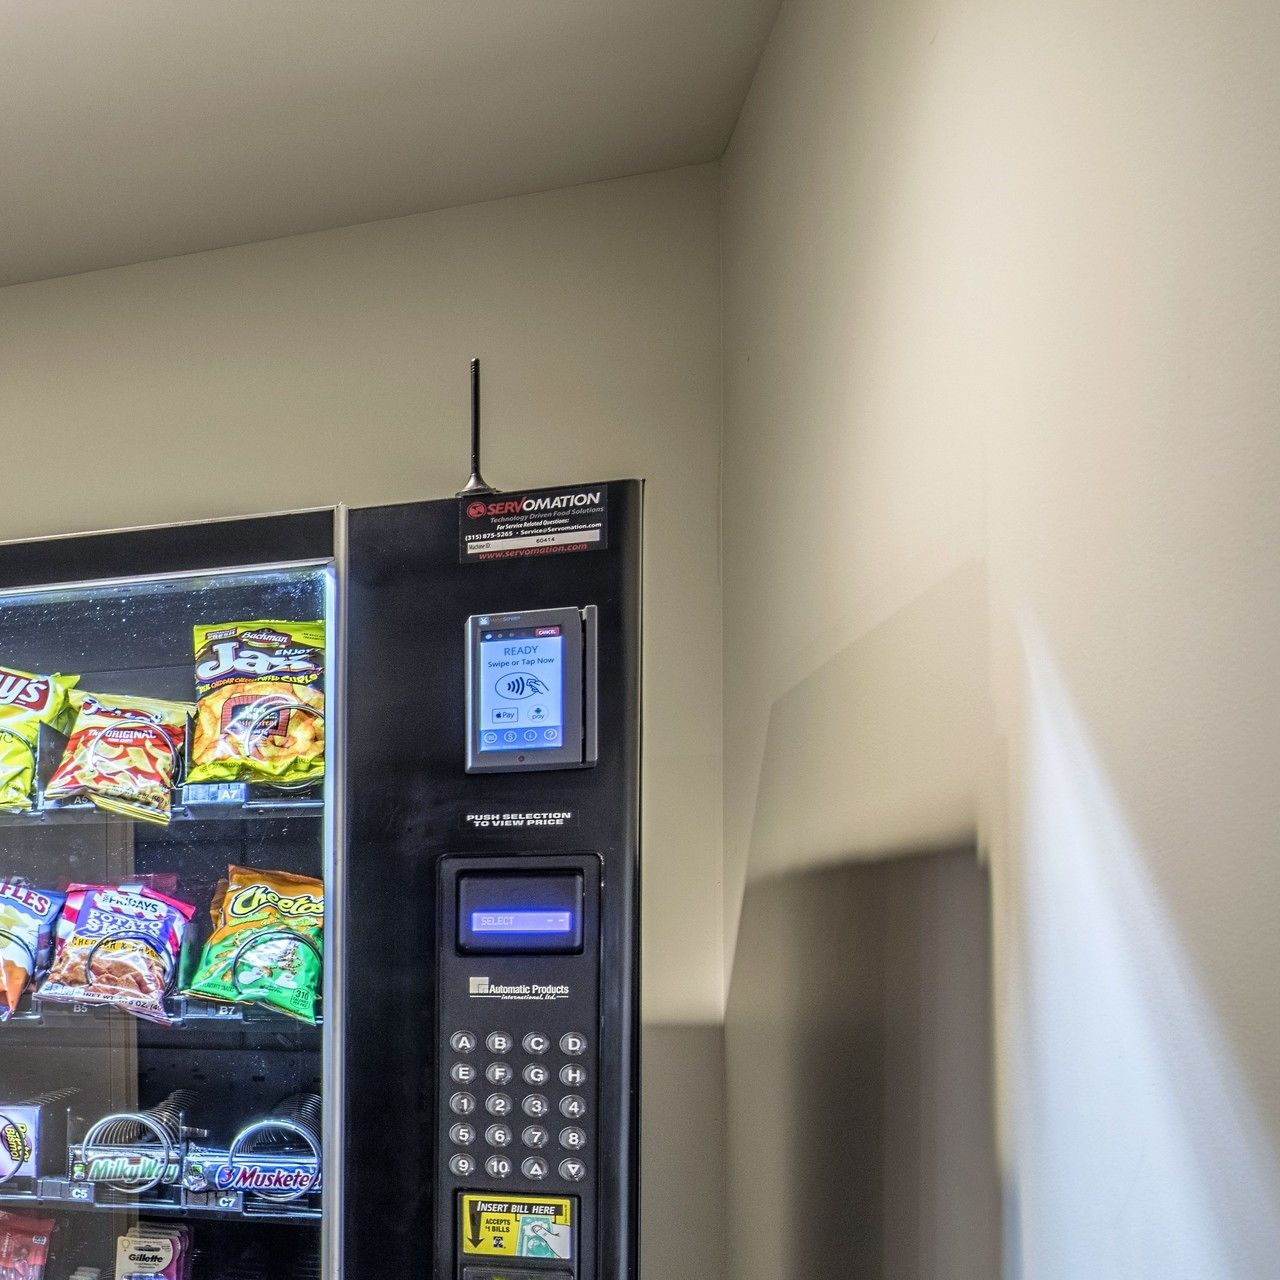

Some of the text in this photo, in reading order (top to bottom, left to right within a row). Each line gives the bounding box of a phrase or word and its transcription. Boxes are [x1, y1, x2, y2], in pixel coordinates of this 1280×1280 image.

[487, 492, 600, 514] SERVOMATION
[490, 506, 604, 523] Technology Driven Food Solutions
[505, 522, 523, 530] Service
[523, 520, 542, 528] Related
[465, 534, 482, 542] (315)
[479, 543, 588, 560] www.servomation.com
[241, 631, 288, 643] Bachman
[504, 646, 539, 656] READY
[106, 729, 157, 739] ORIGINAL
[223, 790, 237, 799] A7
[466, 812, 571, 822] PUSH SELECTION
[492, 819, 525, 827] VIEW
[526, 818, 564, 826] PRICE
[90, 910, 163, 930] POTATO
[481, 916, 515, 926] SELECT
[489, 984, 569, 995] Automatic Products
[219, 1006, 235, 1015] B7
[458, 1036, 471, 1048] A
[494, 1037, 506, 1050] B
[530, 1038, 544, 1050] C
[568, 1038, 580, 1051] D
[459, 1068, 470, 1080] E
[495, 1068, 506, 1080] F
[530, 1068, 544, 1081] G
[568, 1070, 580, 1082] H
[461, 1098, 468, 1111] 1
[495, 1099, 505, 1111] 2
[532, 1100, 542, 1112] 3
[568, 1101, 580, 1113] 4
[459, 1128, 469, 1140] 5
[495, 1130, 505, 1142] 6
[532, 1132, 542, 1143] 7
[568, 1132, 579, 1144] 8
[459, 1159, 469, 1171] 9
[491, 1161, 508, 1173] 10
[220, 1167, 232, 1184] 3
[72, 1189, 88, 1198] C5
[219, 1198, 235, 1207] C7
[476, 1201, 556, 1215] INSERT BILL HERE
[485, 1218, 510, 1226] ACCEPTS
[492, 1225, 510, 1233] BILLS
[128, 1253, 164, 1264] Gillette
